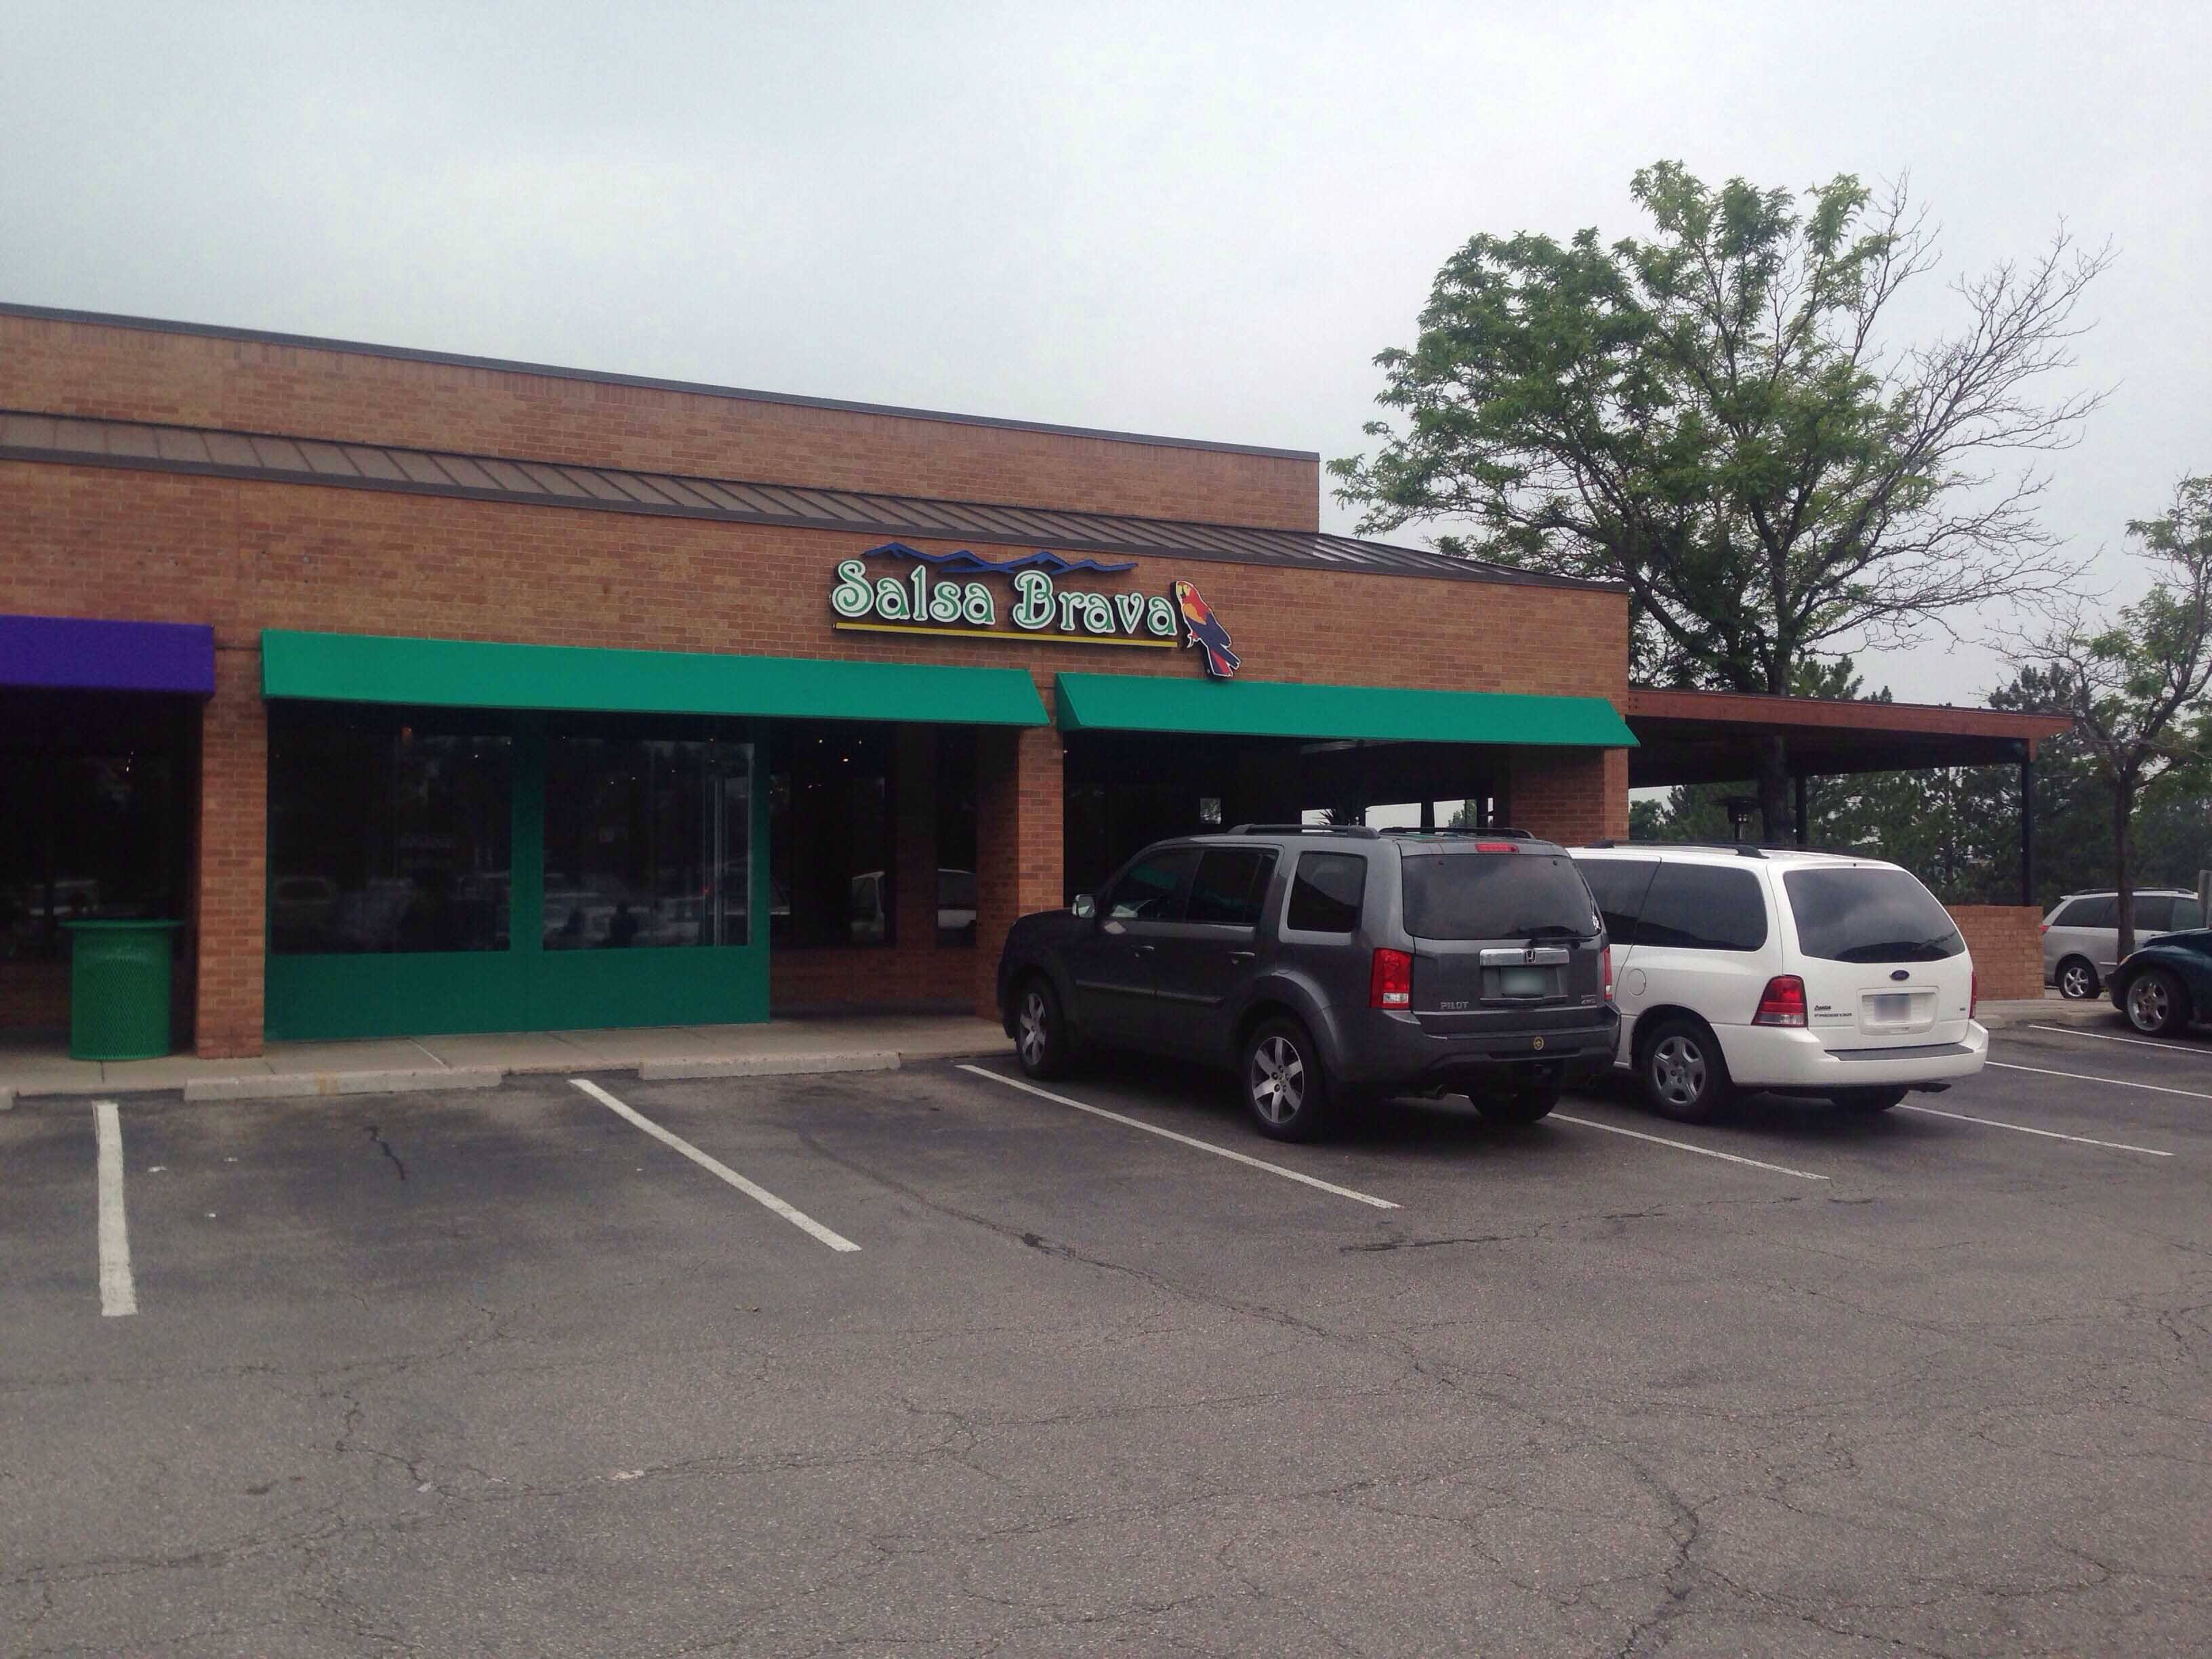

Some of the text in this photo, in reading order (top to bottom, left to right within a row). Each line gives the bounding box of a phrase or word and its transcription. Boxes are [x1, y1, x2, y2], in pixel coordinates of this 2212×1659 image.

[832, 560, 1178, 636] Salsa Brava
[1440, 1002, 1469, 1010] PILOT
